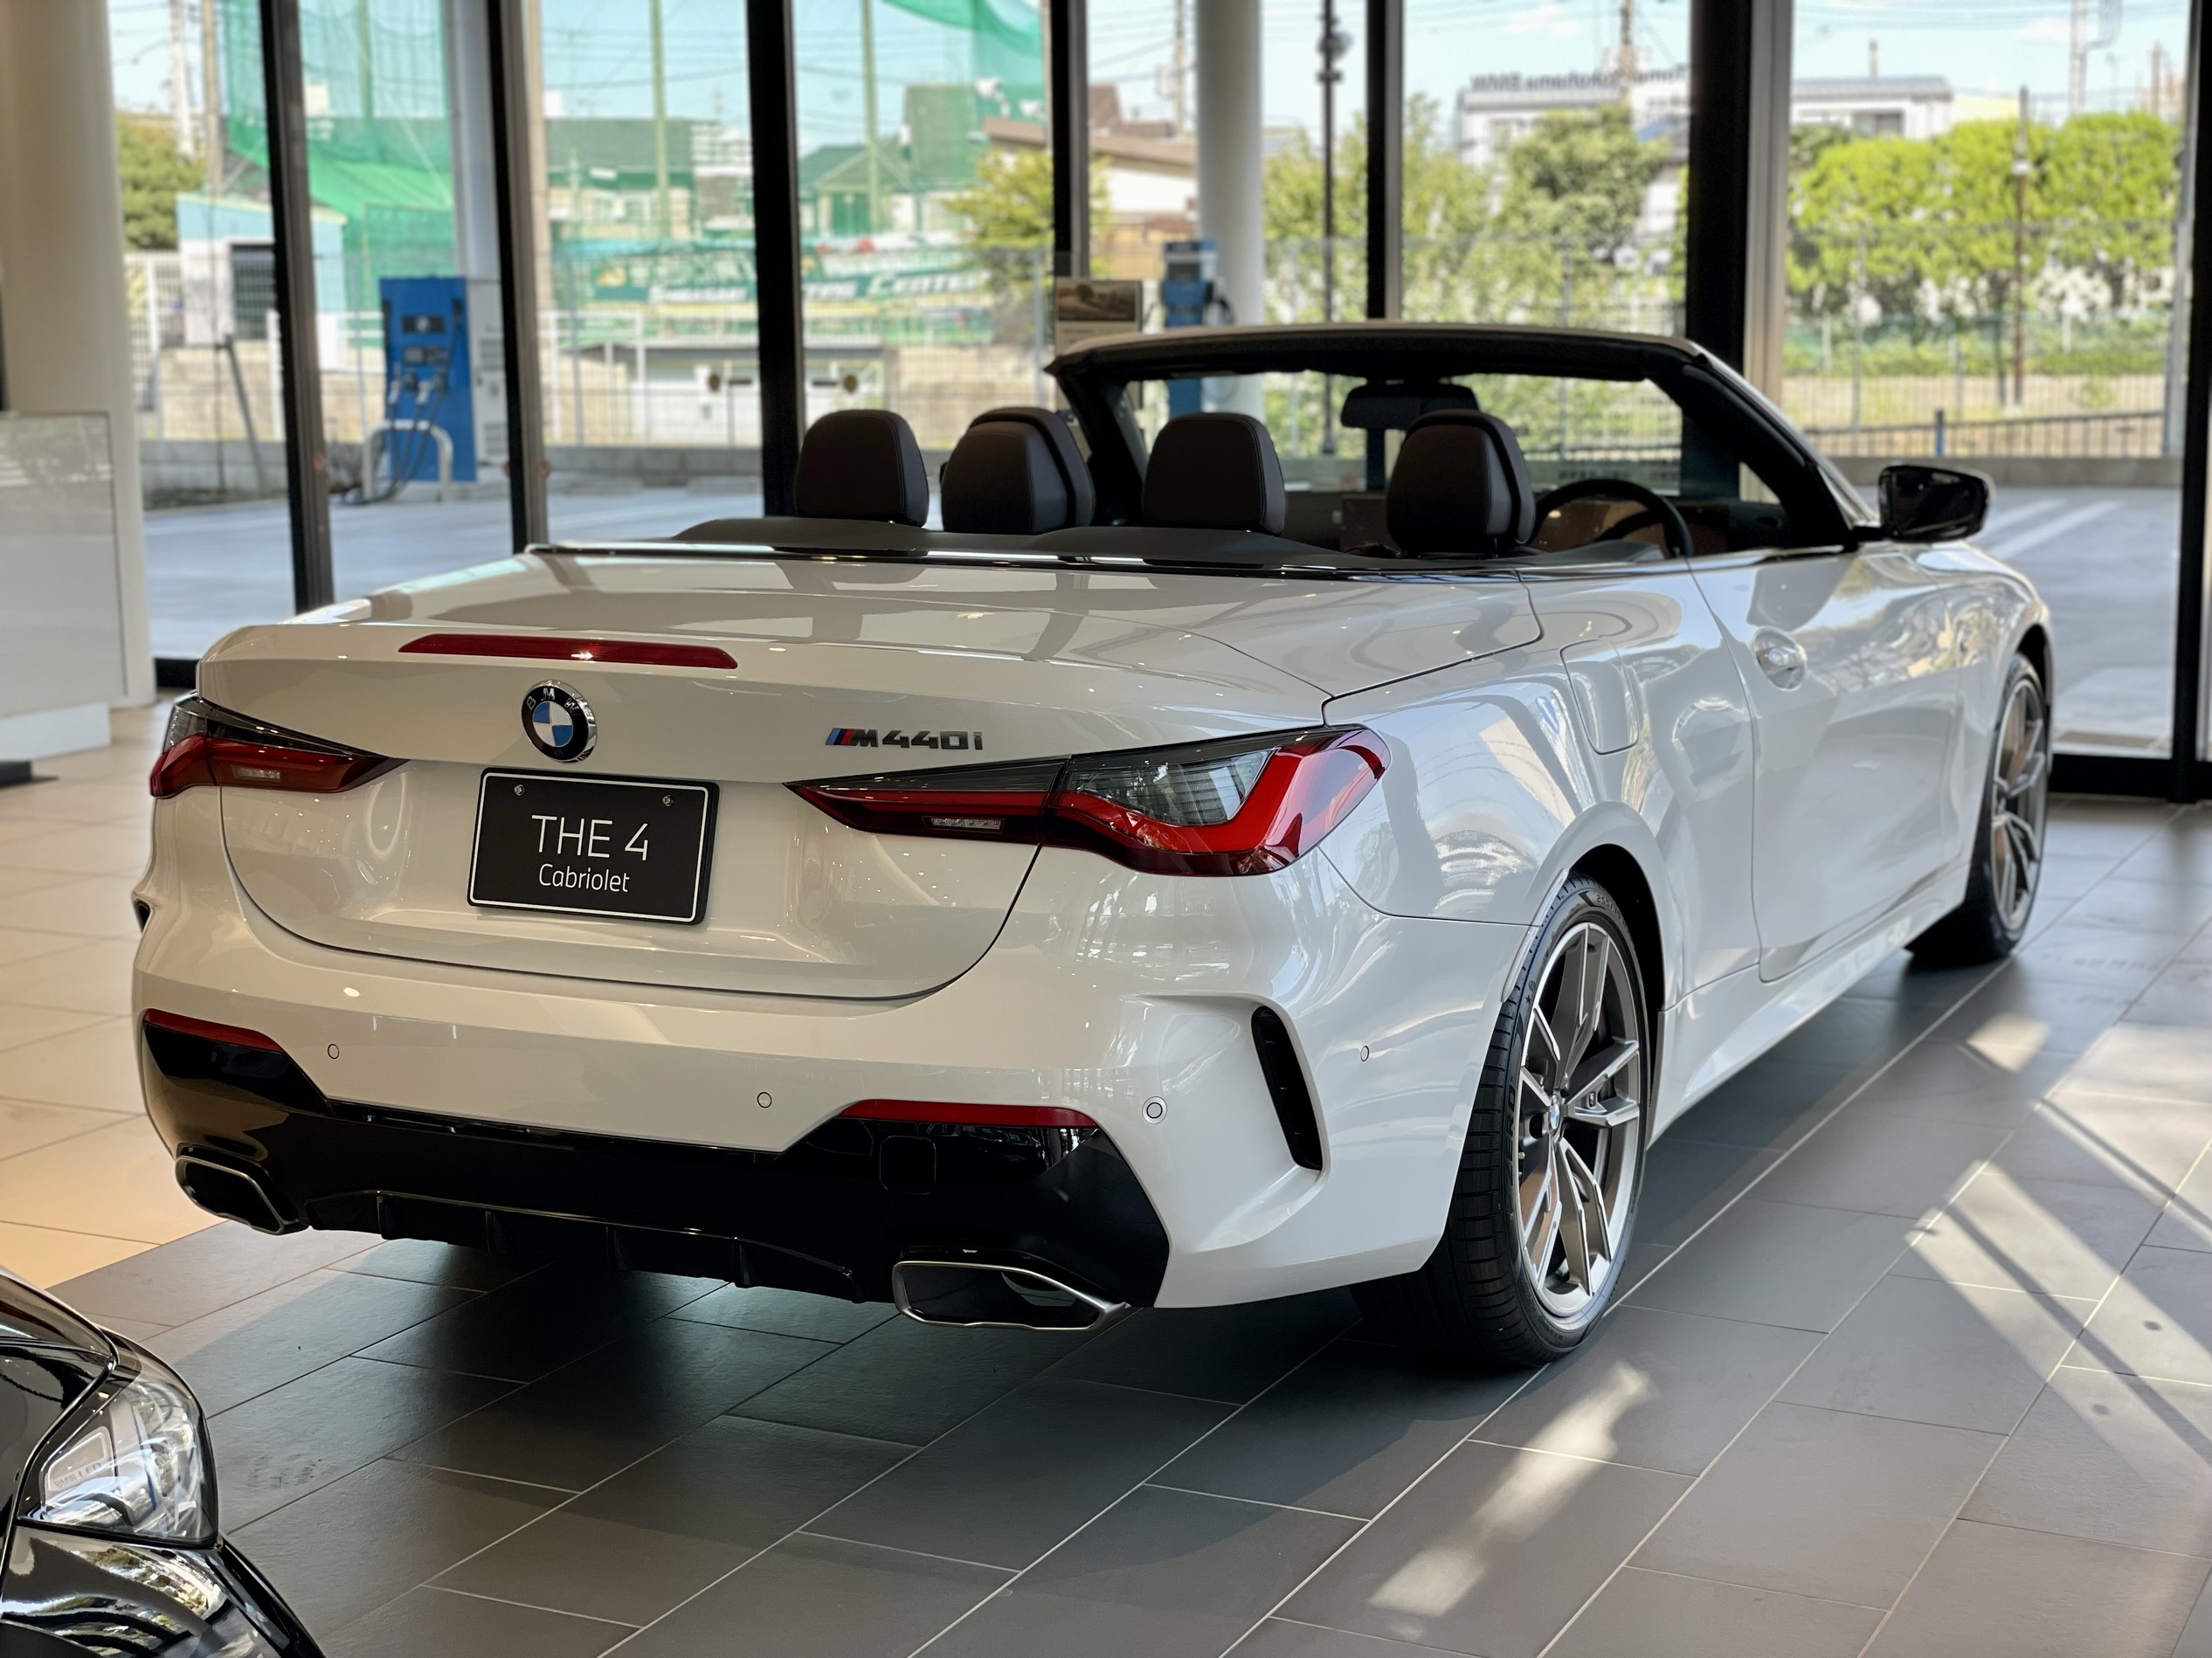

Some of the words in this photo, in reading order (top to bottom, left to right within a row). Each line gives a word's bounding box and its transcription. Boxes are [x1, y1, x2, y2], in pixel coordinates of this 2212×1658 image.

[526, 687, 579, 714] BMW
[850, 728, 984, 750] M440i
[531, 814, 613, 859] THE
[624, 823, 649, 861] 4
[538, 863, 631, 893] Cabriolet
